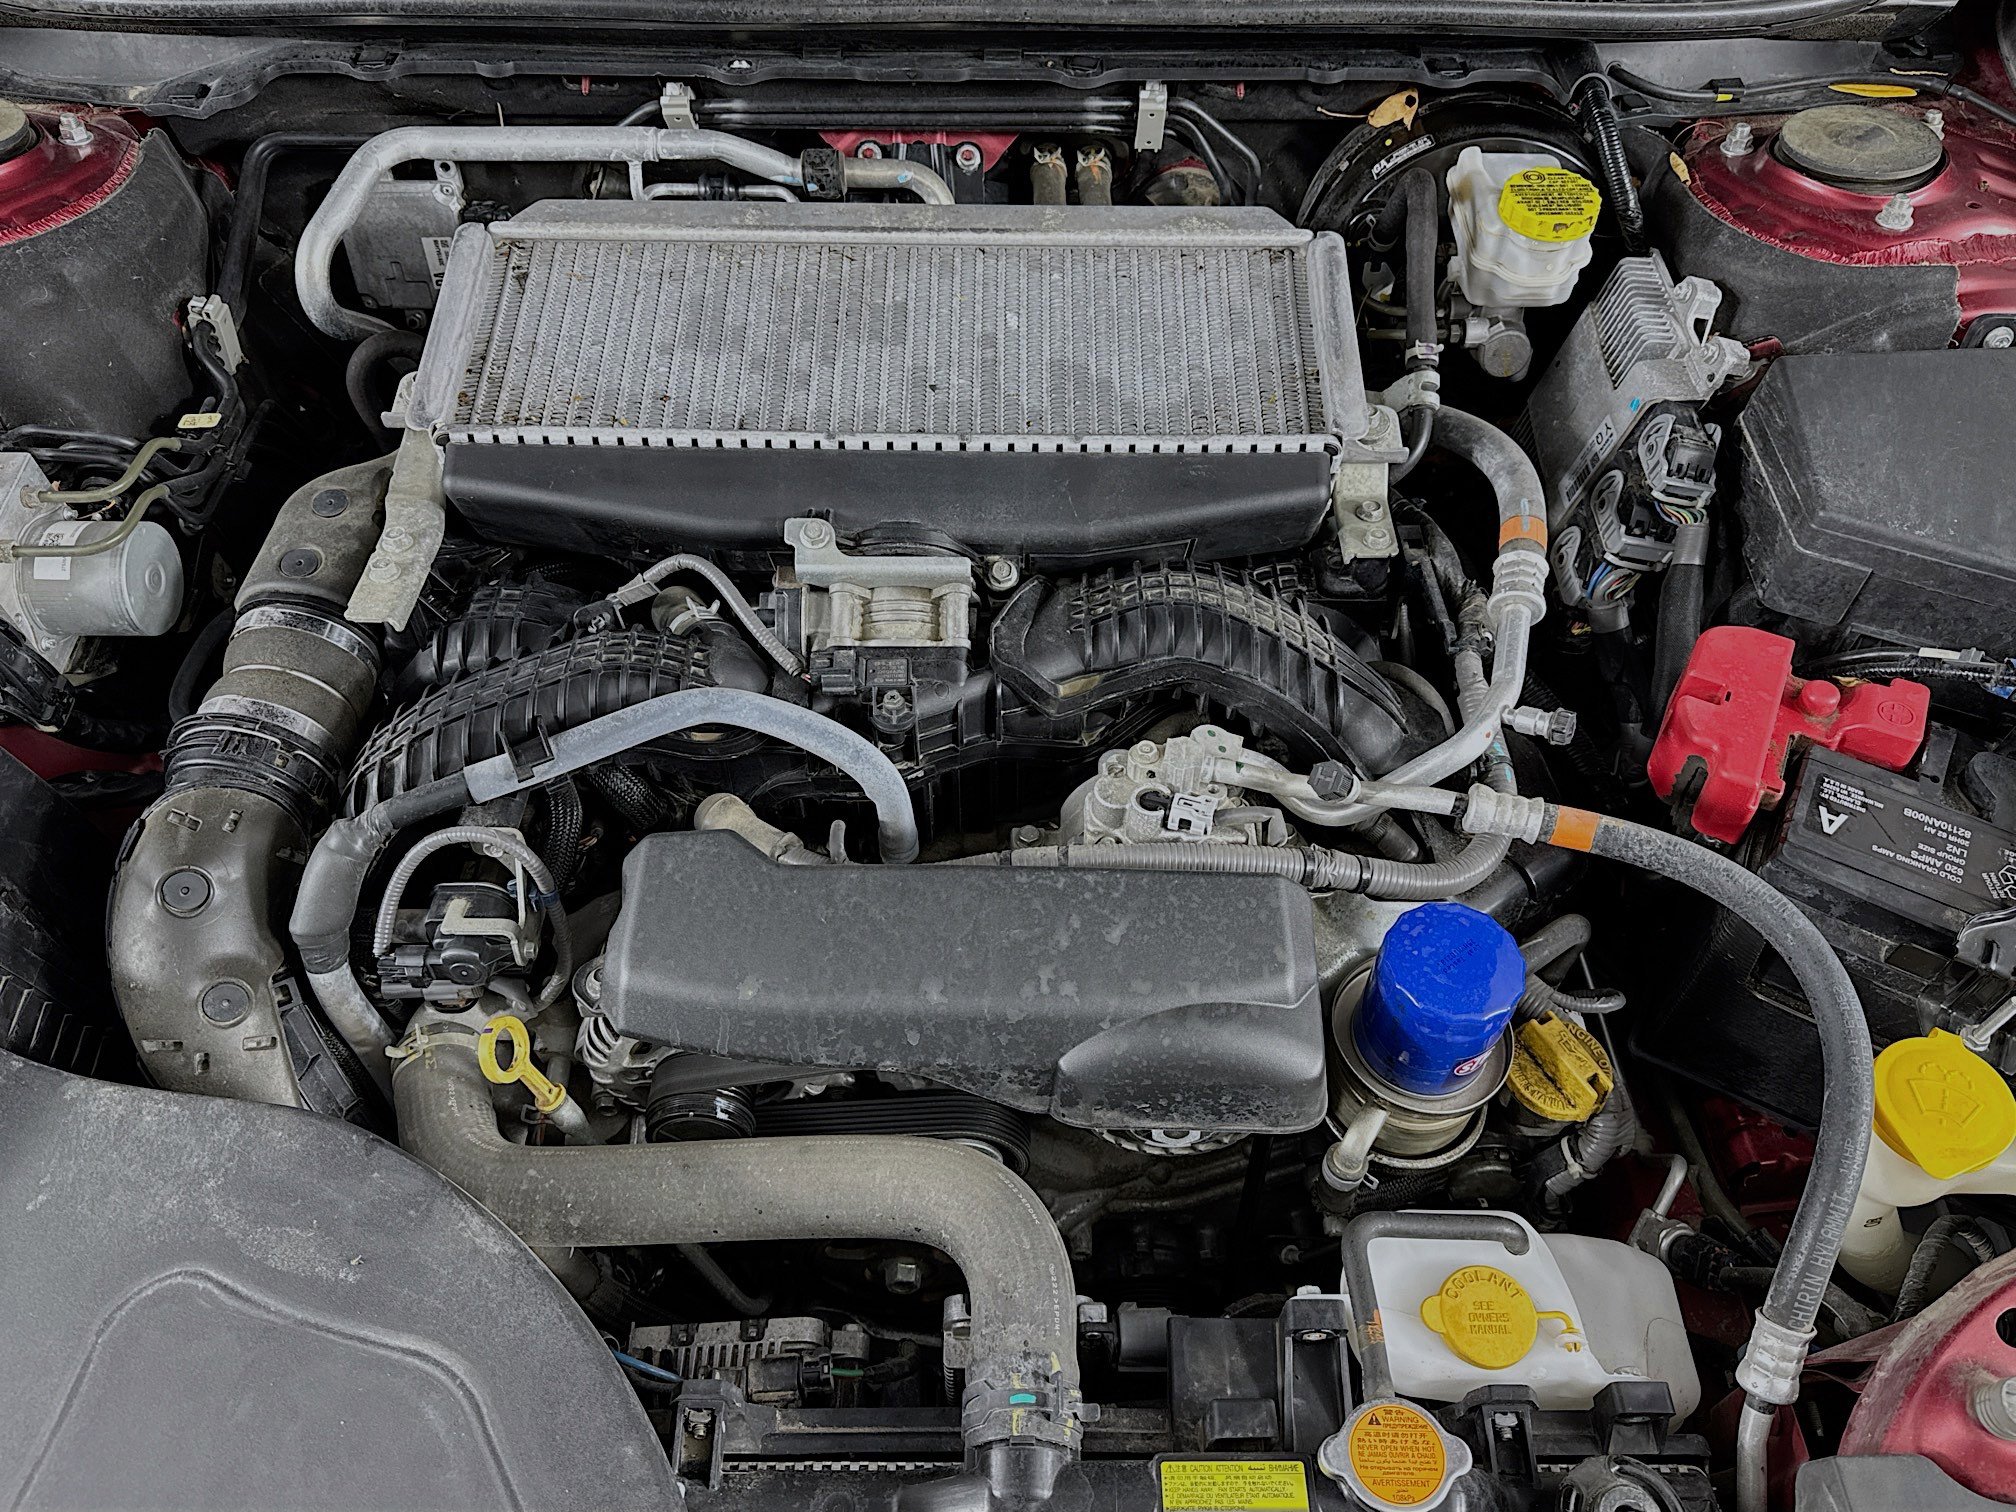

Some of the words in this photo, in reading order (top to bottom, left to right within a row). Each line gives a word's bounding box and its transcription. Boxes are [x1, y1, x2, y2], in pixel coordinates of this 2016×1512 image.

[1828, 794, 1867, 813] DISTRIBUTED
[1903, 806, 1972, 840] 82110AN00B
[1923, 824, 1935, 835] AH
[1936, 829, 1948, 840] 62
[1947, 834, 1970, 848] 20HR
[1871, 843, 1895, 859] AMPS
[1917, 842, 1936, 855] SIZE
[1945, 843, 1968, 858] LN2
[1894, 852, 1939, 876] CRANKING
[1910, 849, 1943, 869] AMPS
[1936, 849, 1966, 866] GROUP
[1938, 868, 1963, 885] COLD
[1943, 863, 1965, 877] 620
[1981, 871, 2000, 900] RETOUR
[1989, 871, 2007, 899] RETURN
[1566, 1022, 1604, 1057] NGINE
[1445, 1269, 1523, 1299] COOLANT
[1472, 1300, 1495, 1311] SEE
[1189, 1464, 1213, 1473] CAUTION
[1215, 1464, 1244, 1472] ATTENTION
[1372, 1479, 1430, 1488] AVERTISSEMENT
